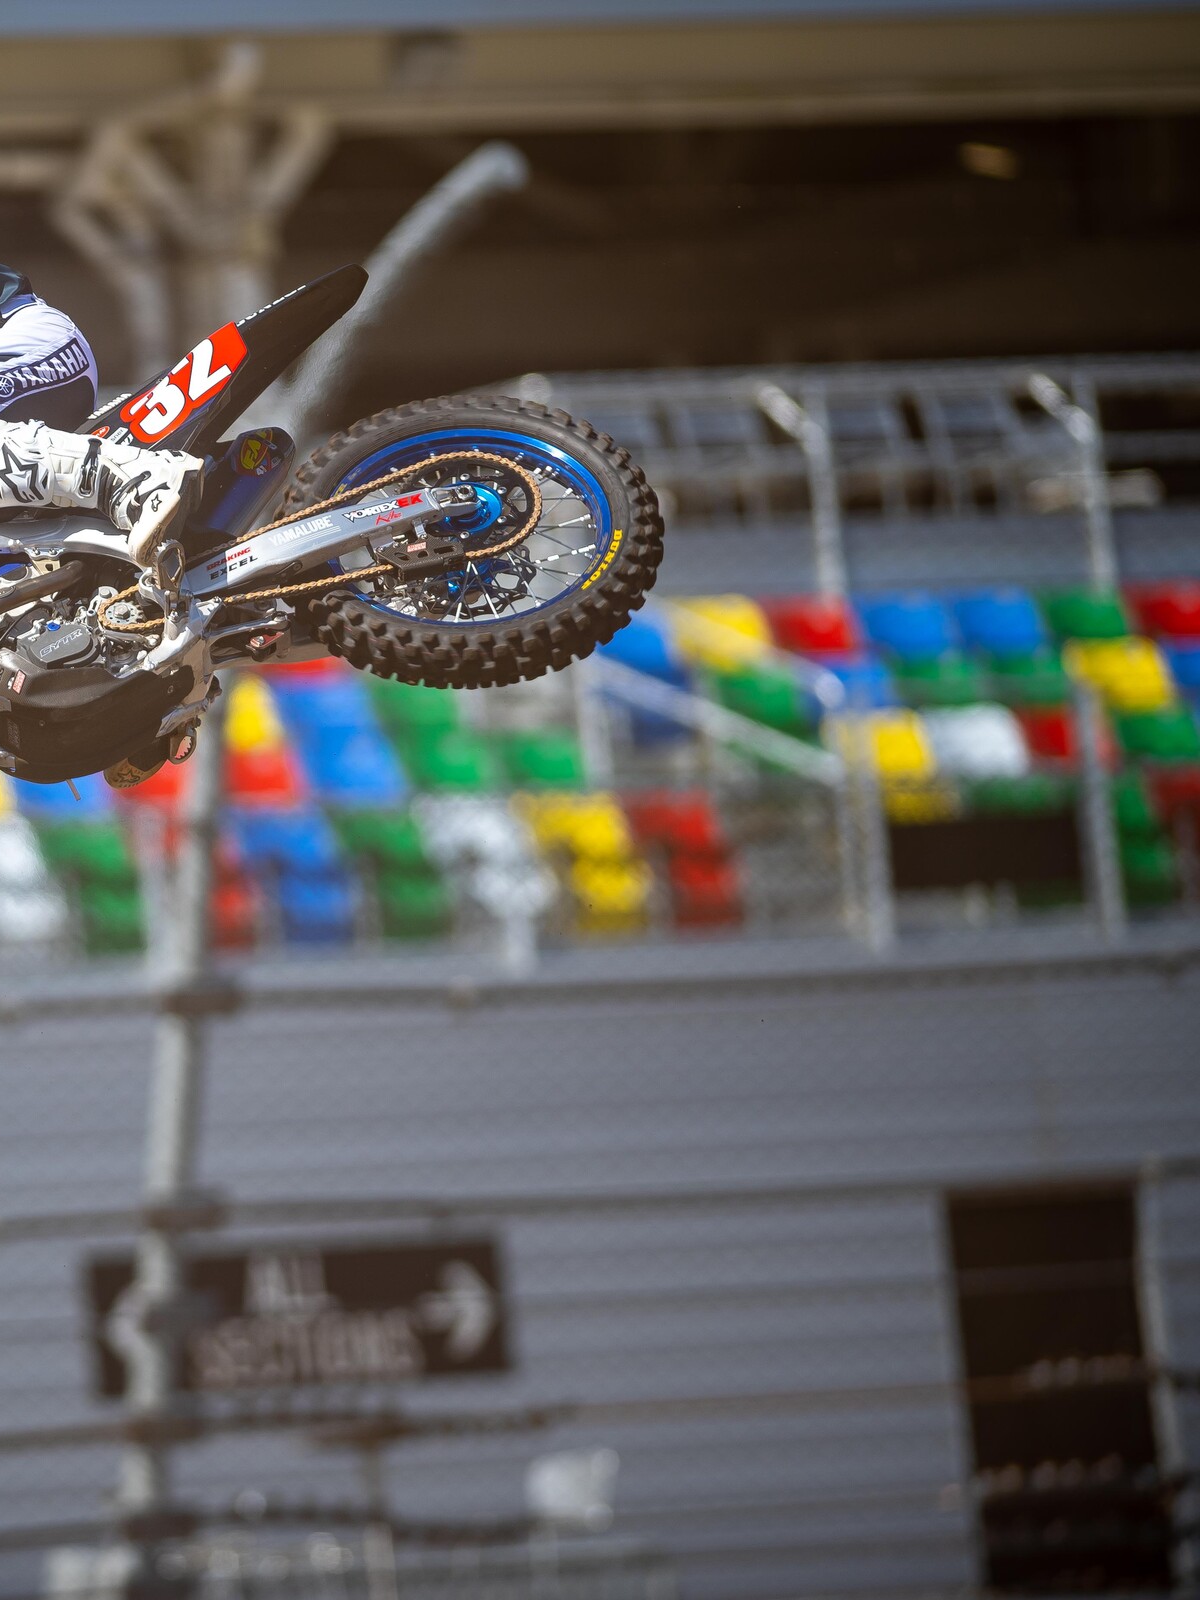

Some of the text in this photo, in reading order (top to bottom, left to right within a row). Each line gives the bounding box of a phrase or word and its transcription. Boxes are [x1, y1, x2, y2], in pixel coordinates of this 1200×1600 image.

[5, 343, 88, 388] YAMAHA
[129, 338, 232, 435] 32
[87, 393, 132, 419] YAMAHA
[343, 493, 424, 523] VORTEX EK
[269, 515, 333, 546] YAMALUBE
[207, 547, 251, 570] BRAKING
[210, 555, 258, 580] EXCEL
[581, 529, 623, 590] DUNLOP
[40, 628, 83, 658] GYTR
